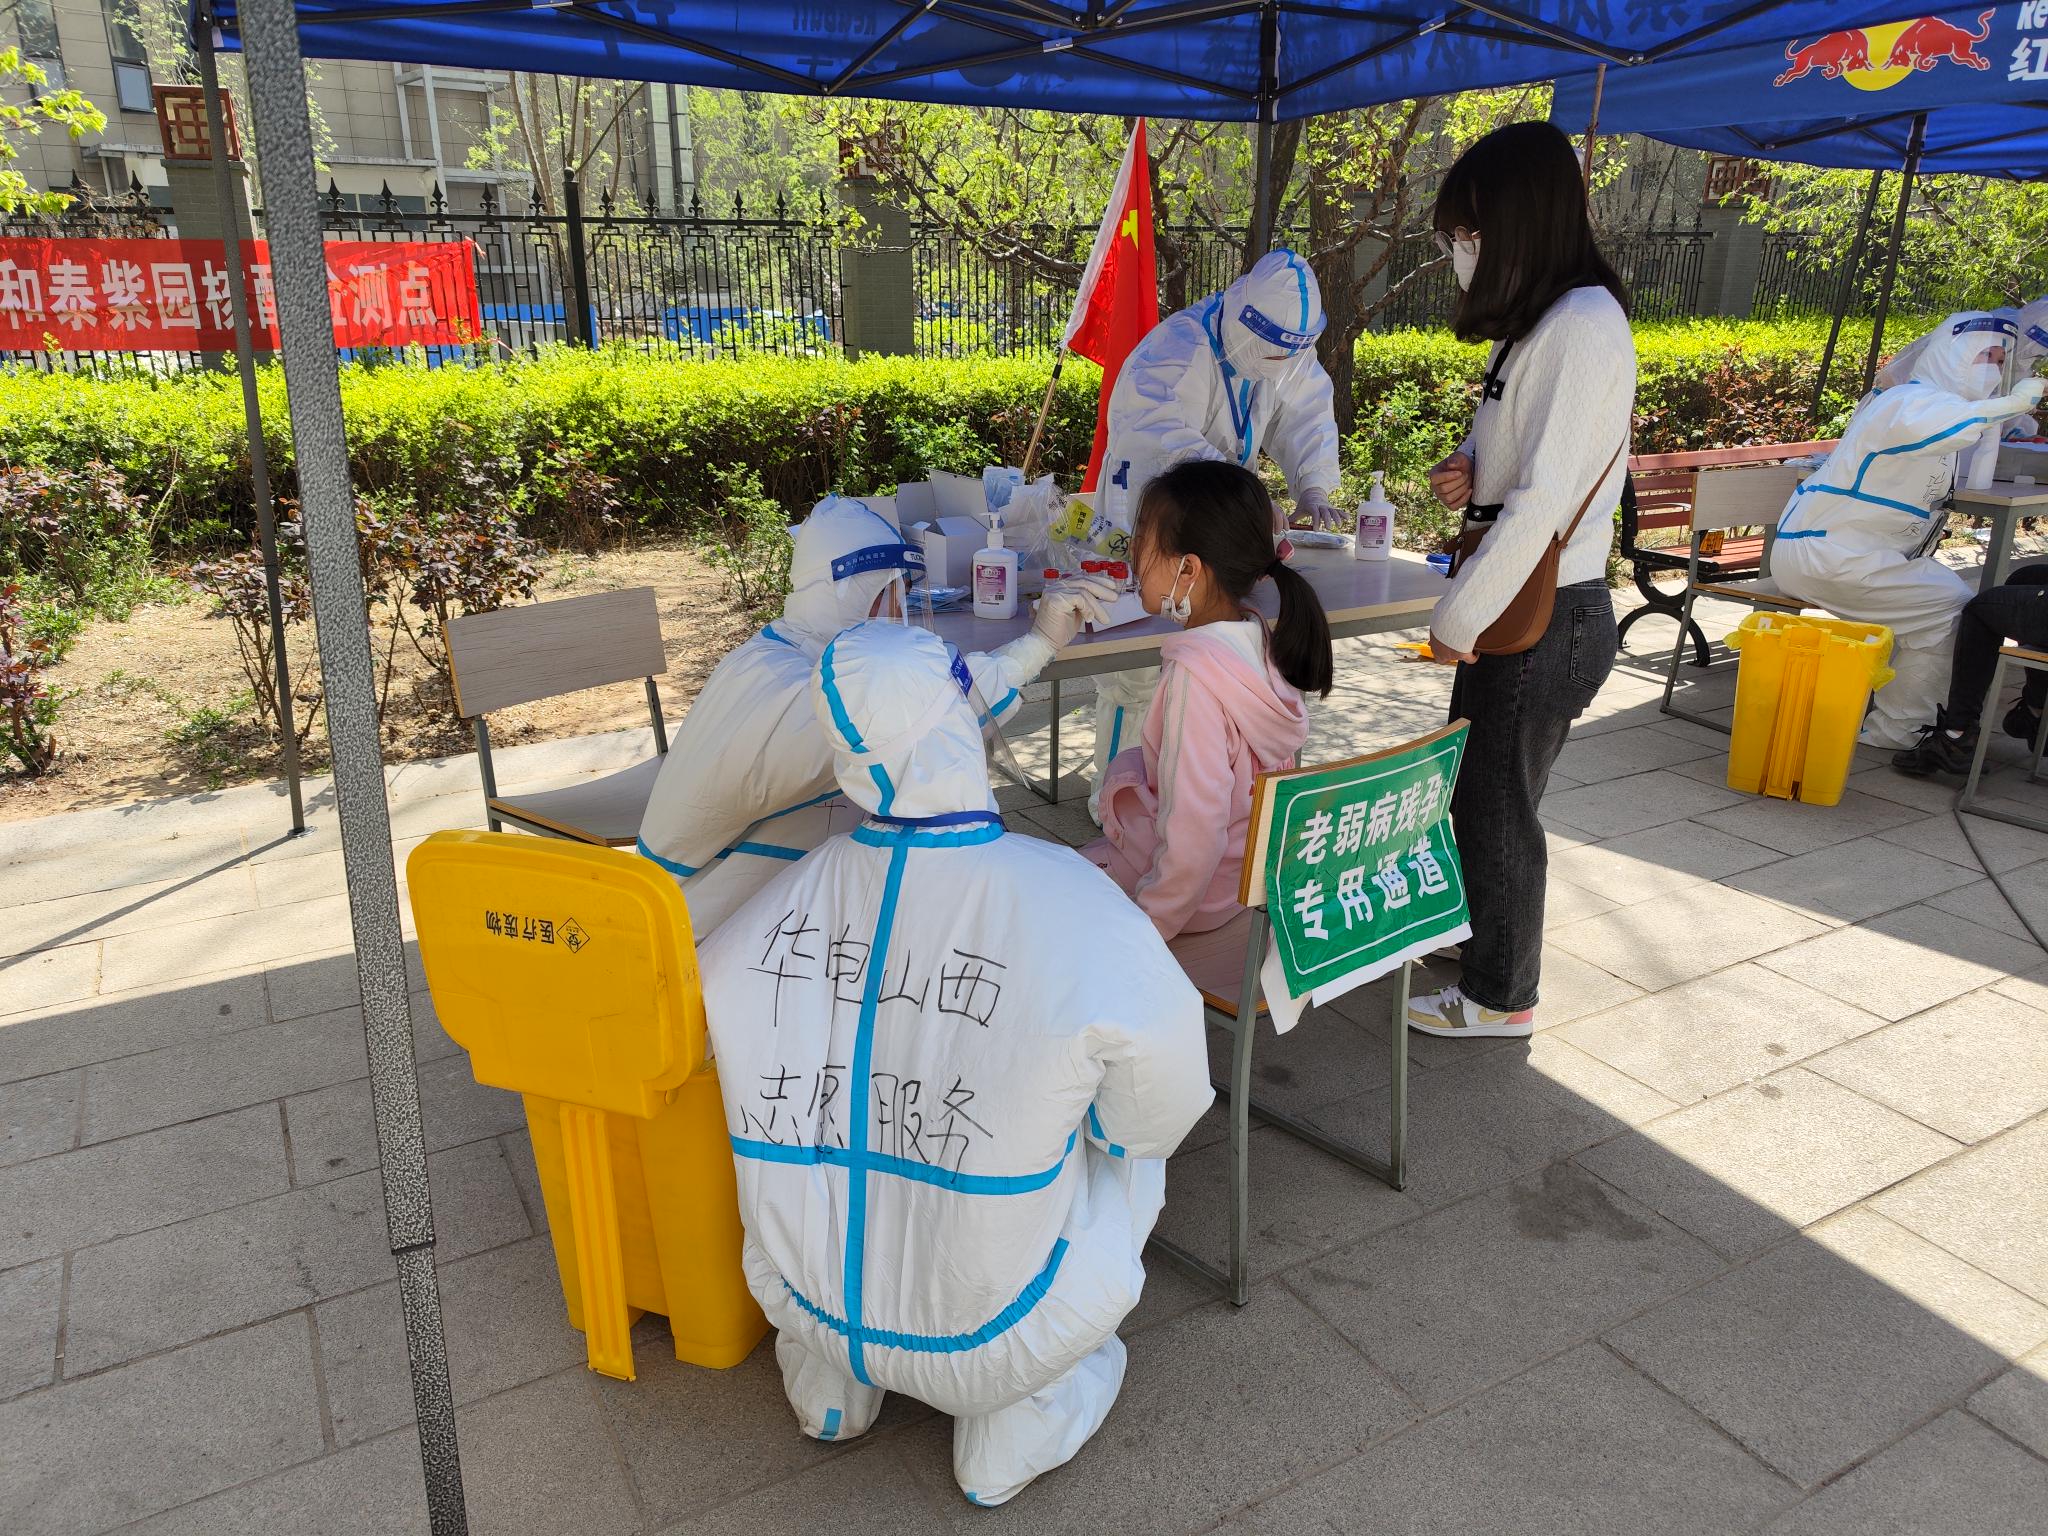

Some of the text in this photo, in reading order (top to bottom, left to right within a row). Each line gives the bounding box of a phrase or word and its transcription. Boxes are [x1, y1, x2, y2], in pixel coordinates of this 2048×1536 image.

[1296, 772, 1442, 865] 老弱病残孕
[485, 909, 555, 944] 医疗废物
[1293, 836, 1449, 940] 专用通道
[747, 909, 1007, 1028] 华电山西
[740, 1064, 994, 1184] 志愿服务
